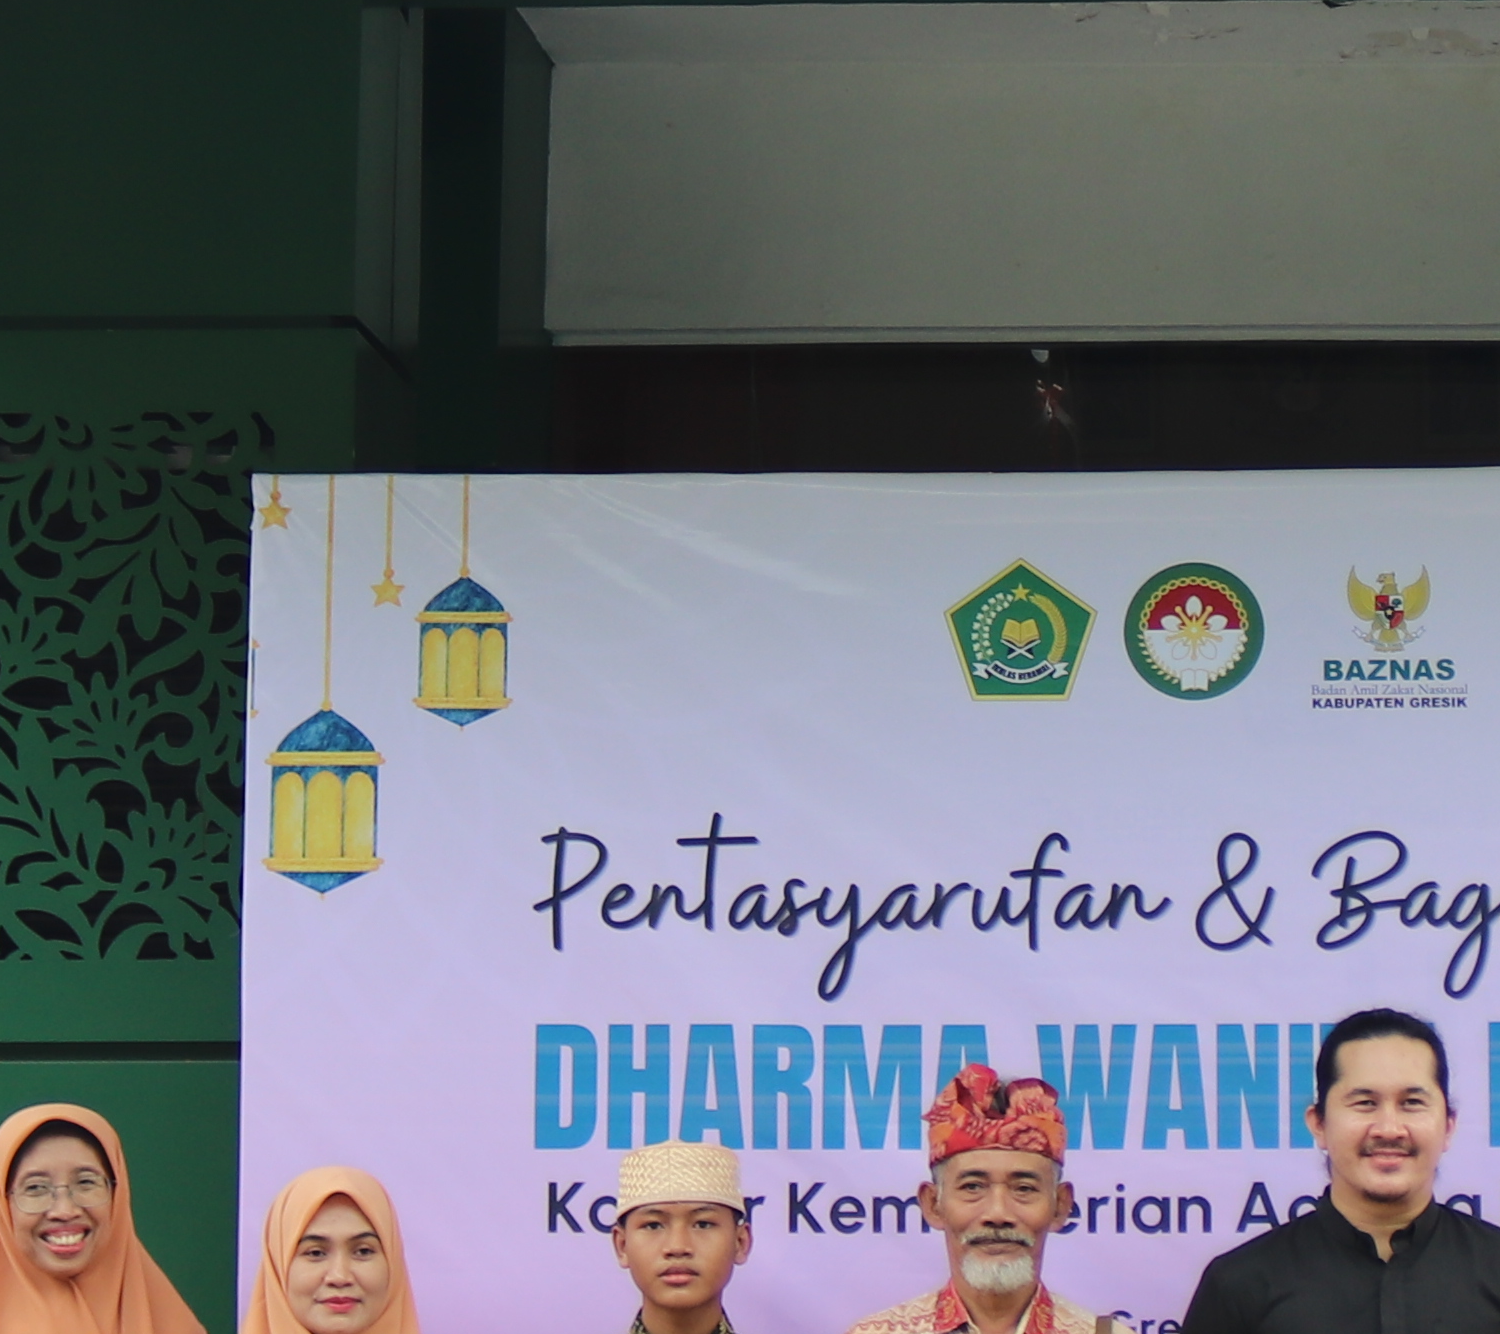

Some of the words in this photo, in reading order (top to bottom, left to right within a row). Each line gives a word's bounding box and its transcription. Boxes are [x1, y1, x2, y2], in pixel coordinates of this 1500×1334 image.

[1323, 658, 1456, 681] BAZNAS
[1311, 684, 1347, 696] Badan
[1350, 684, 1378, 696] Amil
[1382, 684, 1414, 696] Zakat
[1418, 683, 1468, 696] Nasional
[1312, 697, 1404, 709] KABUPATEN
[1409, 697, 1468, 709] GRESIK
[532, 812, 1173, 1003] Pentasyarufan
[1194, 831, 1278, 953] &
[1036, 1023, 1437, 1150] WANI
